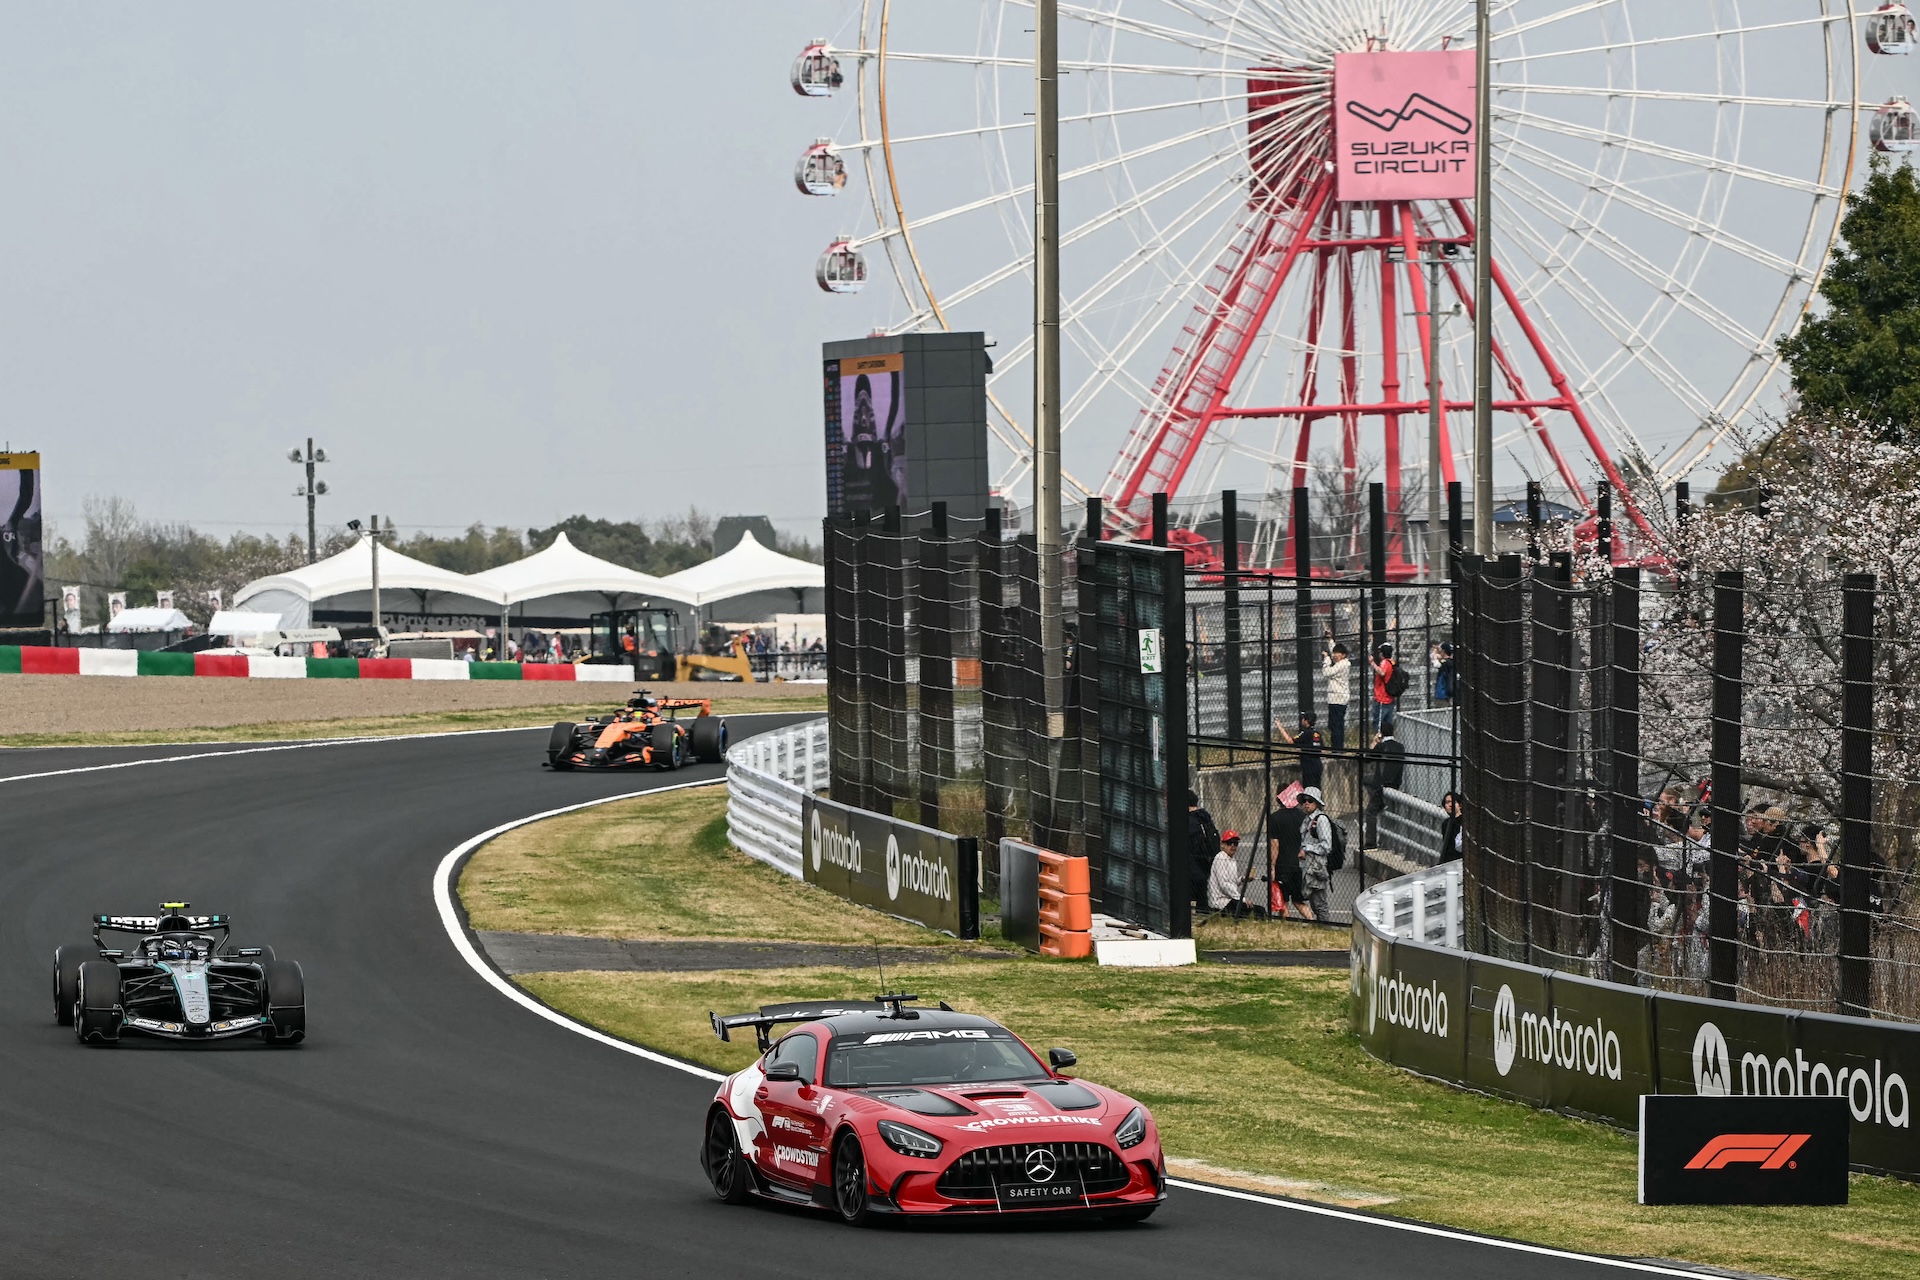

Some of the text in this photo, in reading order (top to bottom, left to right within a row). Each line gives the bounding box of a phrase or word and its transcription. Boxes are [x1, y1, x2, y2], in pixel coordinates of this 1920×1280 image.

[1351, 140, 1469, 156] SUZUKA
[1354, 159, 1467, 174] CIRCUIT
[397, 614, 450, 627] Drivers
[451, 615, 487, 627] 2026
[823, 824, 862, 874] motorola
[902, 850, 952, 901] motorola
[1378, 971, 1448, 1037] motorola
[904, 1029, 990, 1041] AMG
[1521, 1007, 1622, 1081] motorola
[967, 1115, 1103, 1130] CROWDSTRIKE
[1683, 1133, 1813, 1170] F1
[1009, 1186, 1072, 1198] SAFETY CAR
